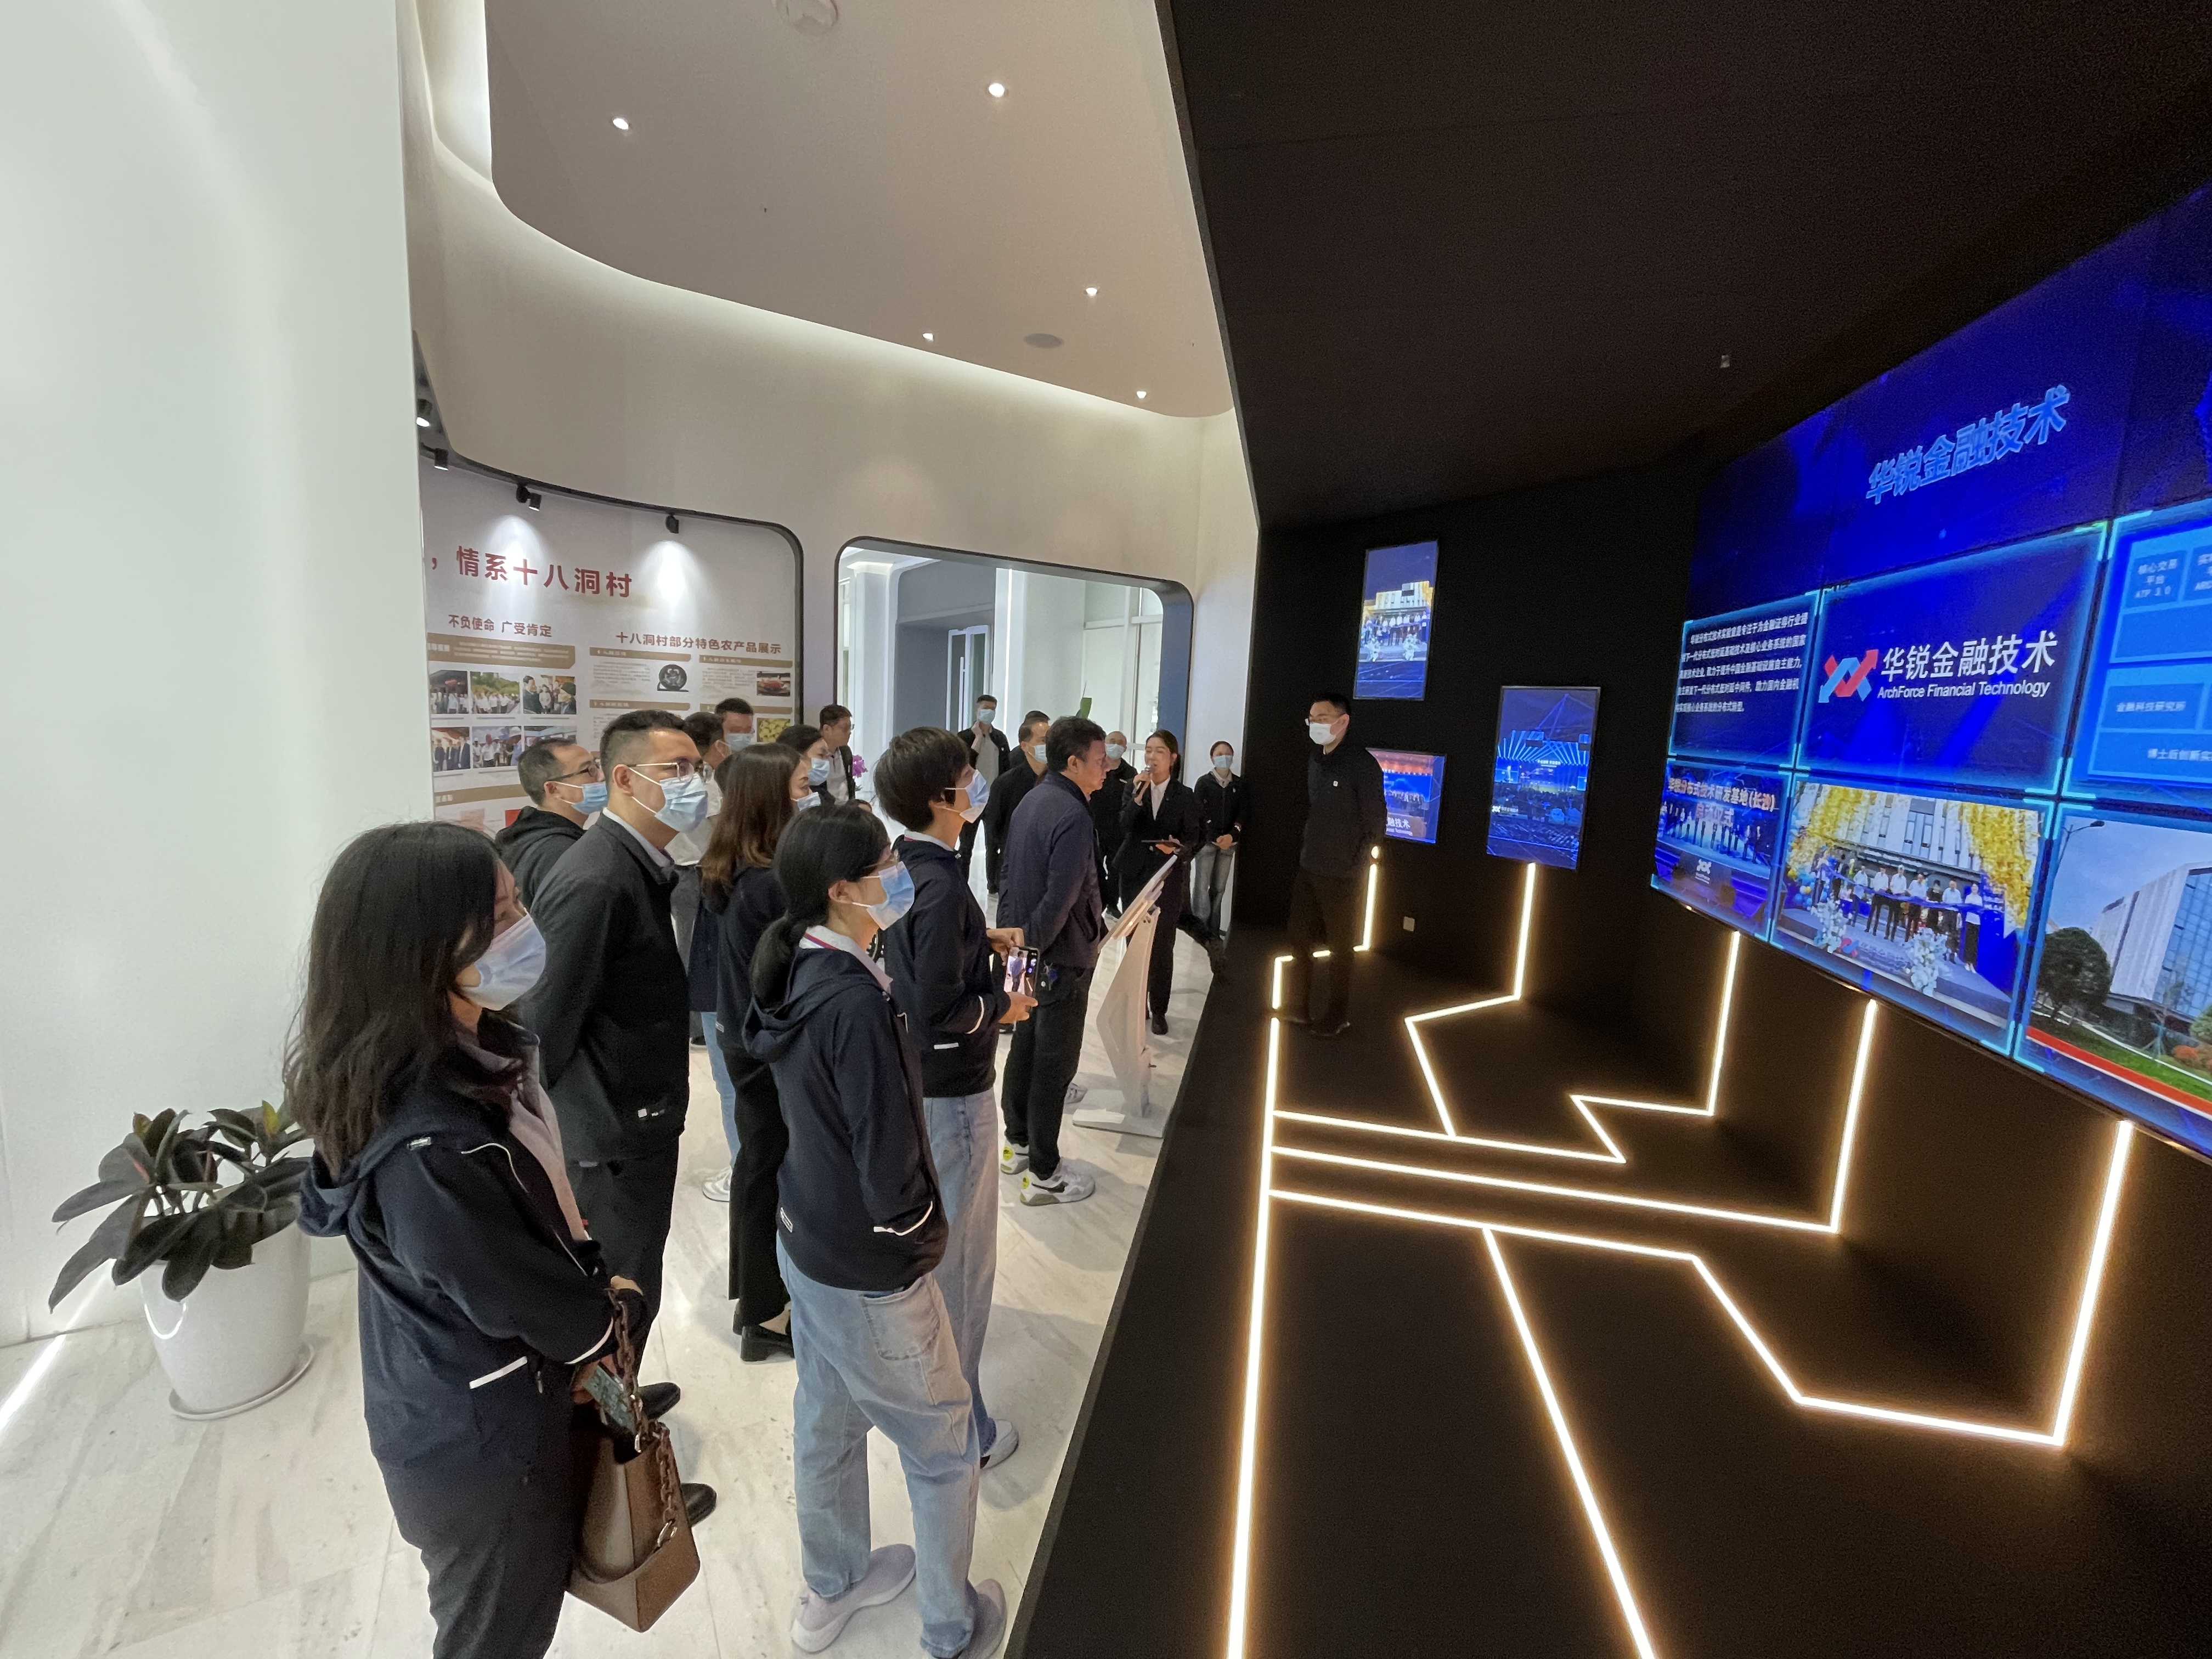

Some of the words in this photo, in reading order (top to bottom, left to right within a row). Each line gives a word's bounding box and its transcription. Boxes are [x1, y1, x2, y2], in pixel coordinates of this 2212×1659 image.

[1866, 385, 2070, 505] 华锐金融技术
[448, 614, 494, 631] 不负使命
[501, 621, 552, 637] 广受肯定
[616, 632, 781, 654] 十八洞村部分特色农产品展示
[1881, 630, 2058, 682] 华锐金融技术
[1877, 686, 1925, 699] ArchForce
[1927, 682, 1976, 697] Financial
[1978, 680, 2051, 698] Technology
